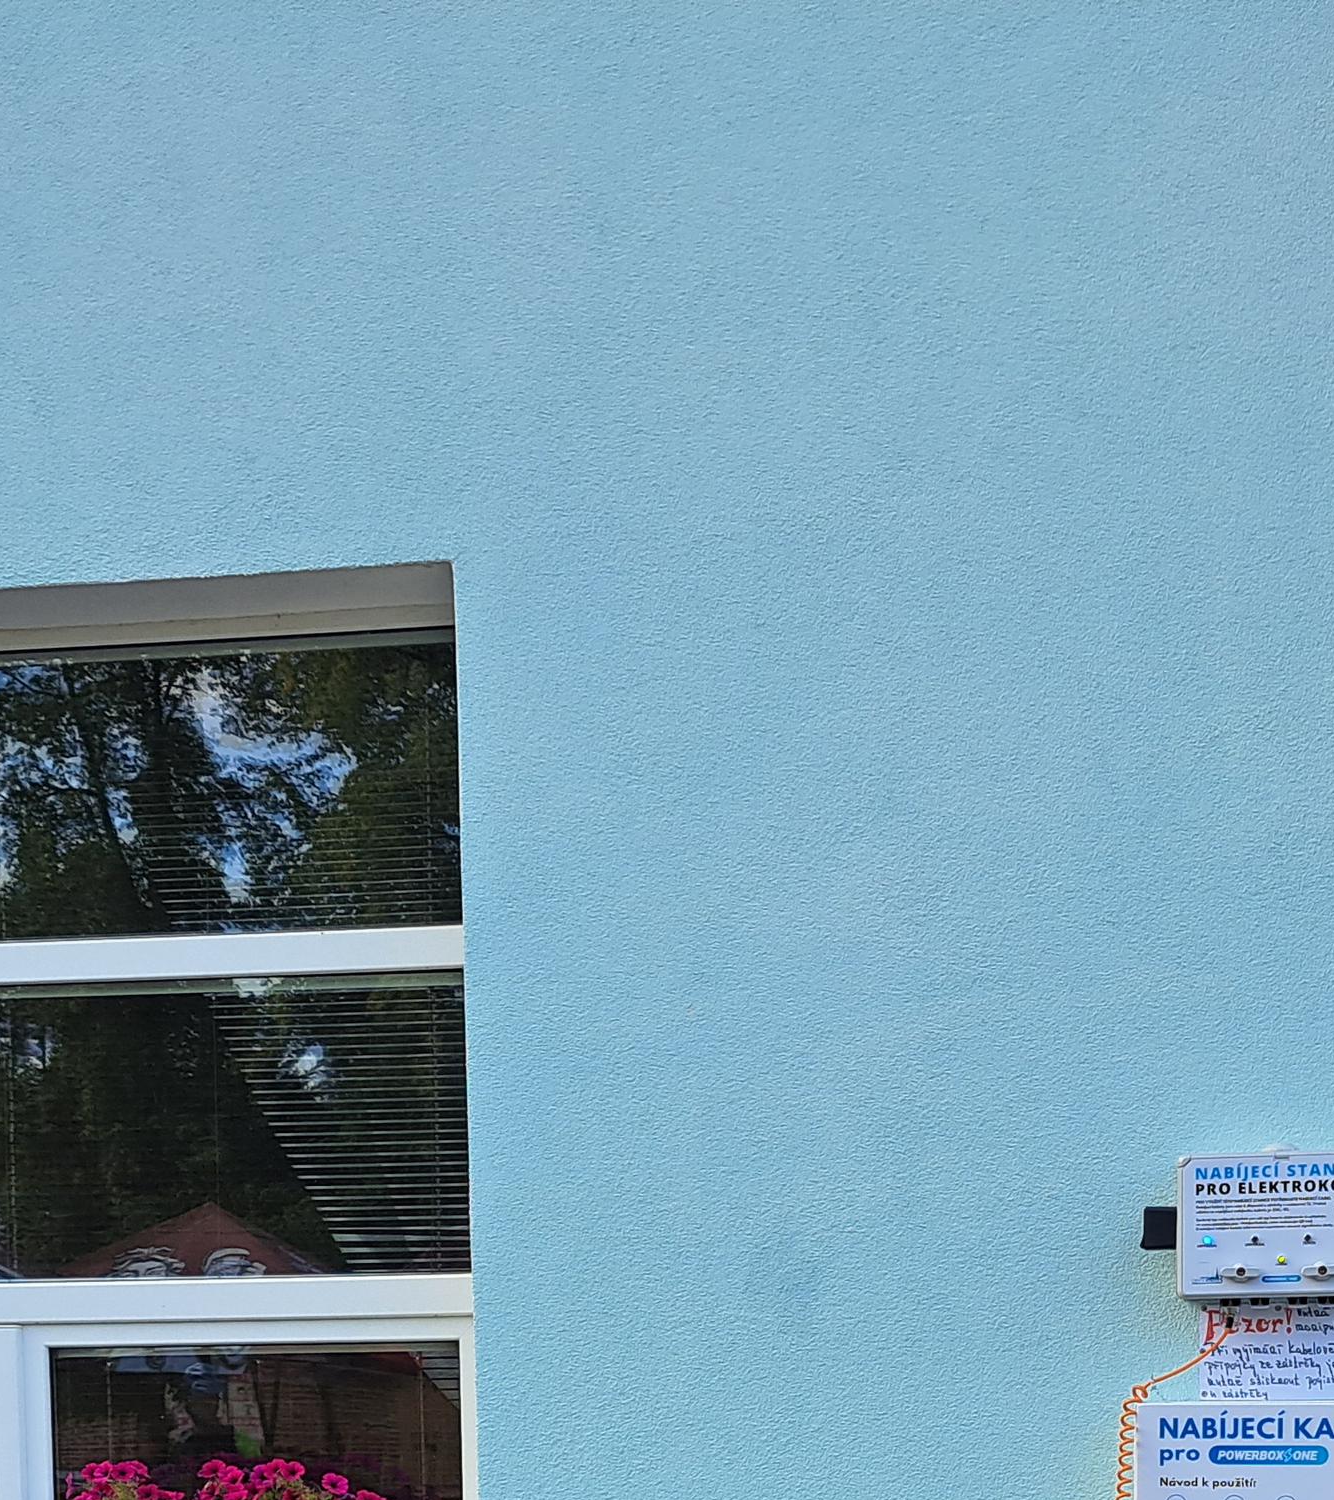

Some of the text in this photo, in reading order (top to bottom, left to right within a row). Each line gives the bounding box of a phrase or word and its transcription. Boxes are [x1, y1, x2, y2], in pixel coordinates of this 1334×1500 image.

[1195, 1161, 1280, 1181] NABÍJECÍ
[1196, 1183, 1231, 1196] PRO
[1159, 1410, 1284, 1440] NABÍJECÍ
[1159, 1448, 1319, 1466] pro POWERBOX ONE
[1159, 1477, 1199, 1488] Návod
[1201, 1477, 1209, 1488] k
